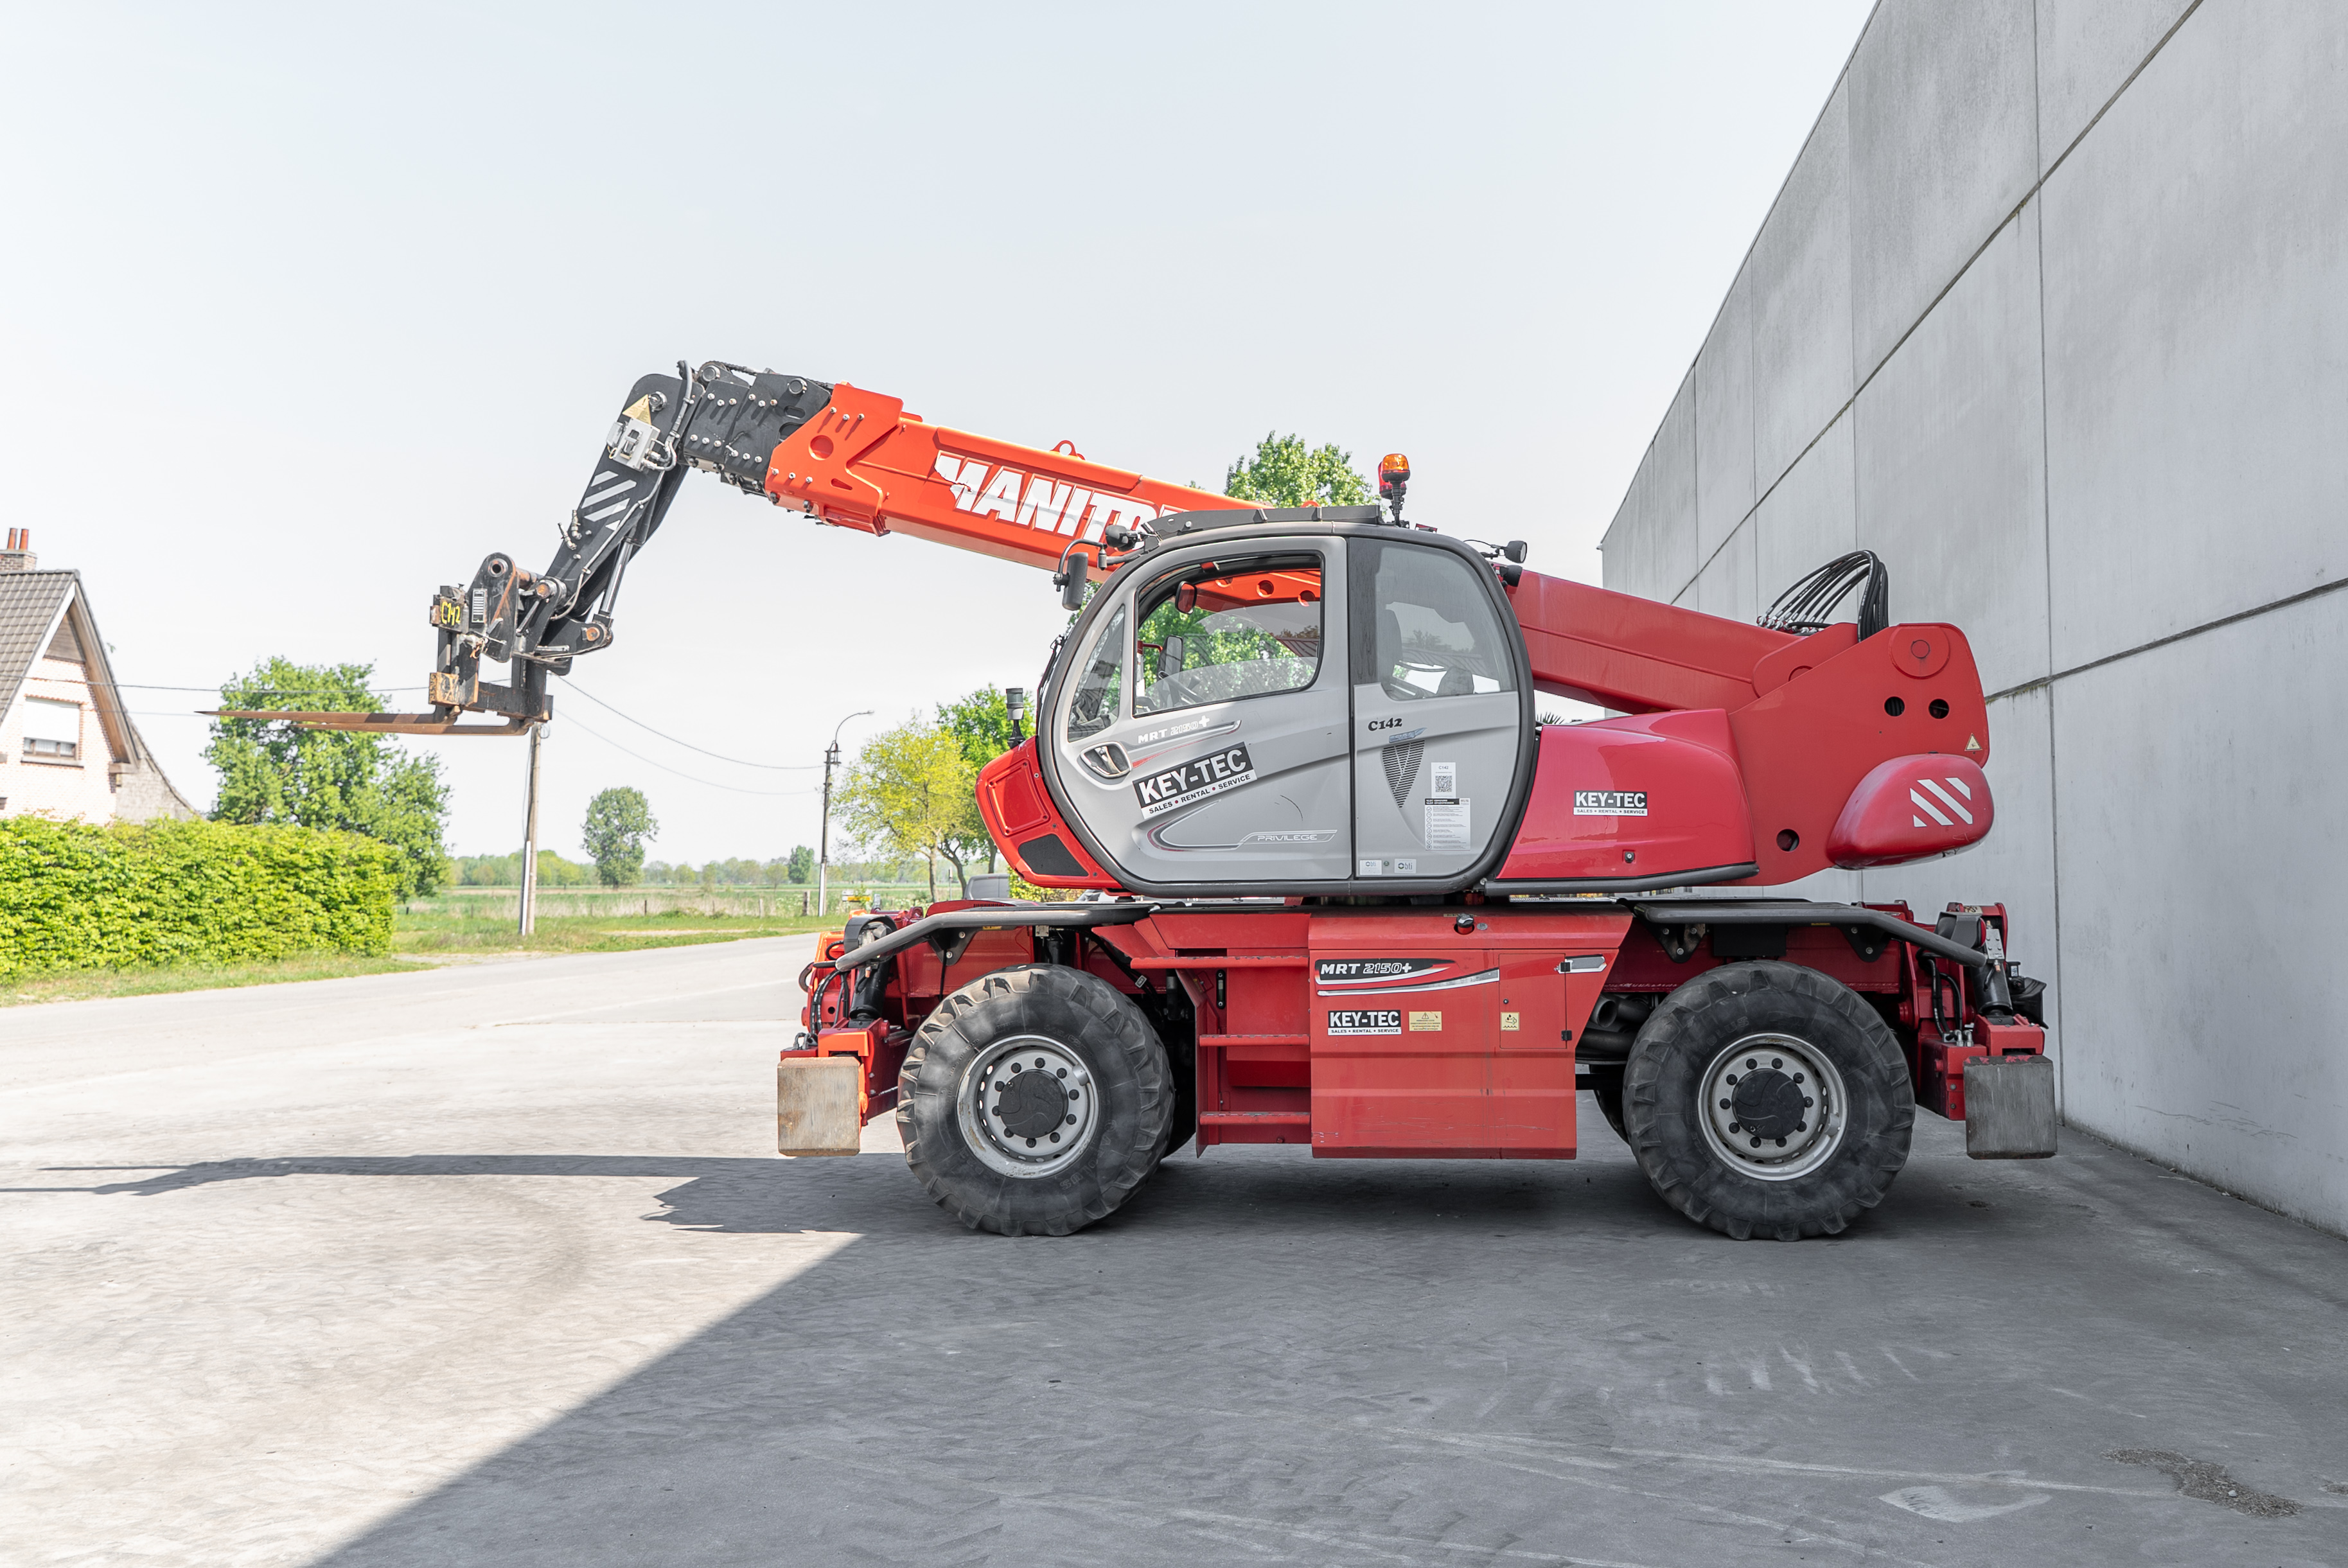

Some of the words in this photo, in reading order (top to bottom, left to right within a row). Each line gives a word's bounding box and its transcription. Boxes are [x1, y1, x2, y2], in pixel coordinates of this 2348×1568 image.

[441, 601, 461, 626] C142
[1368, 718, 1402, 732] C142
[1138, 728, 1168, 744] MRT
[1138, 749, 1247, 805] KEY-TEC
[1149, 801, 1173, 814] SALES
[1181, 788, 1210, 803] RENTAL
[1218, 774, 1251, 789] SERVICE
[1576, 792, 1646, 807] KEY-TEC
[1321, 964, 1361, 974] MRT
[1363, 962, 1412, 974] 2150+
[1330, 1011, 1399, 1027] KEY-TEC
